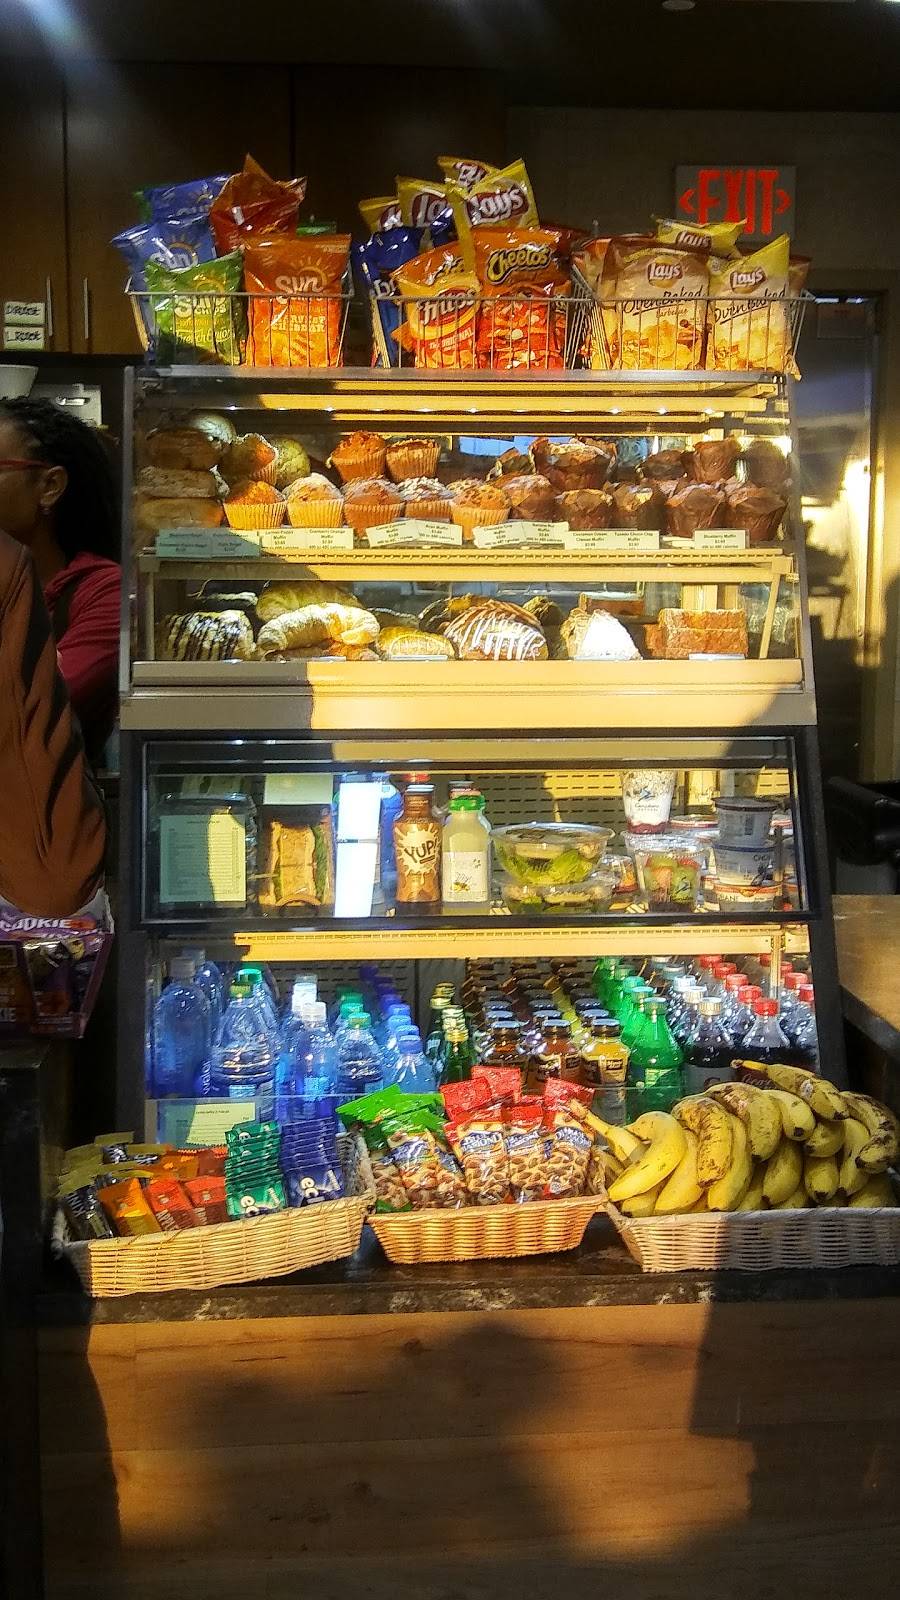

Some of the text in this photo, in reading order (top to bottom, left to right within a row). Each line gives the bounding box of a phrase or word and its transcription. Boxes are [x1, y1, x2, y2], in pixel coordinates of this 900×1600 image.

[696, 169, 780, 236] EXIT
[486, 245, 552, 285] Cheetos
[275, 275, 324, 305] Sun
